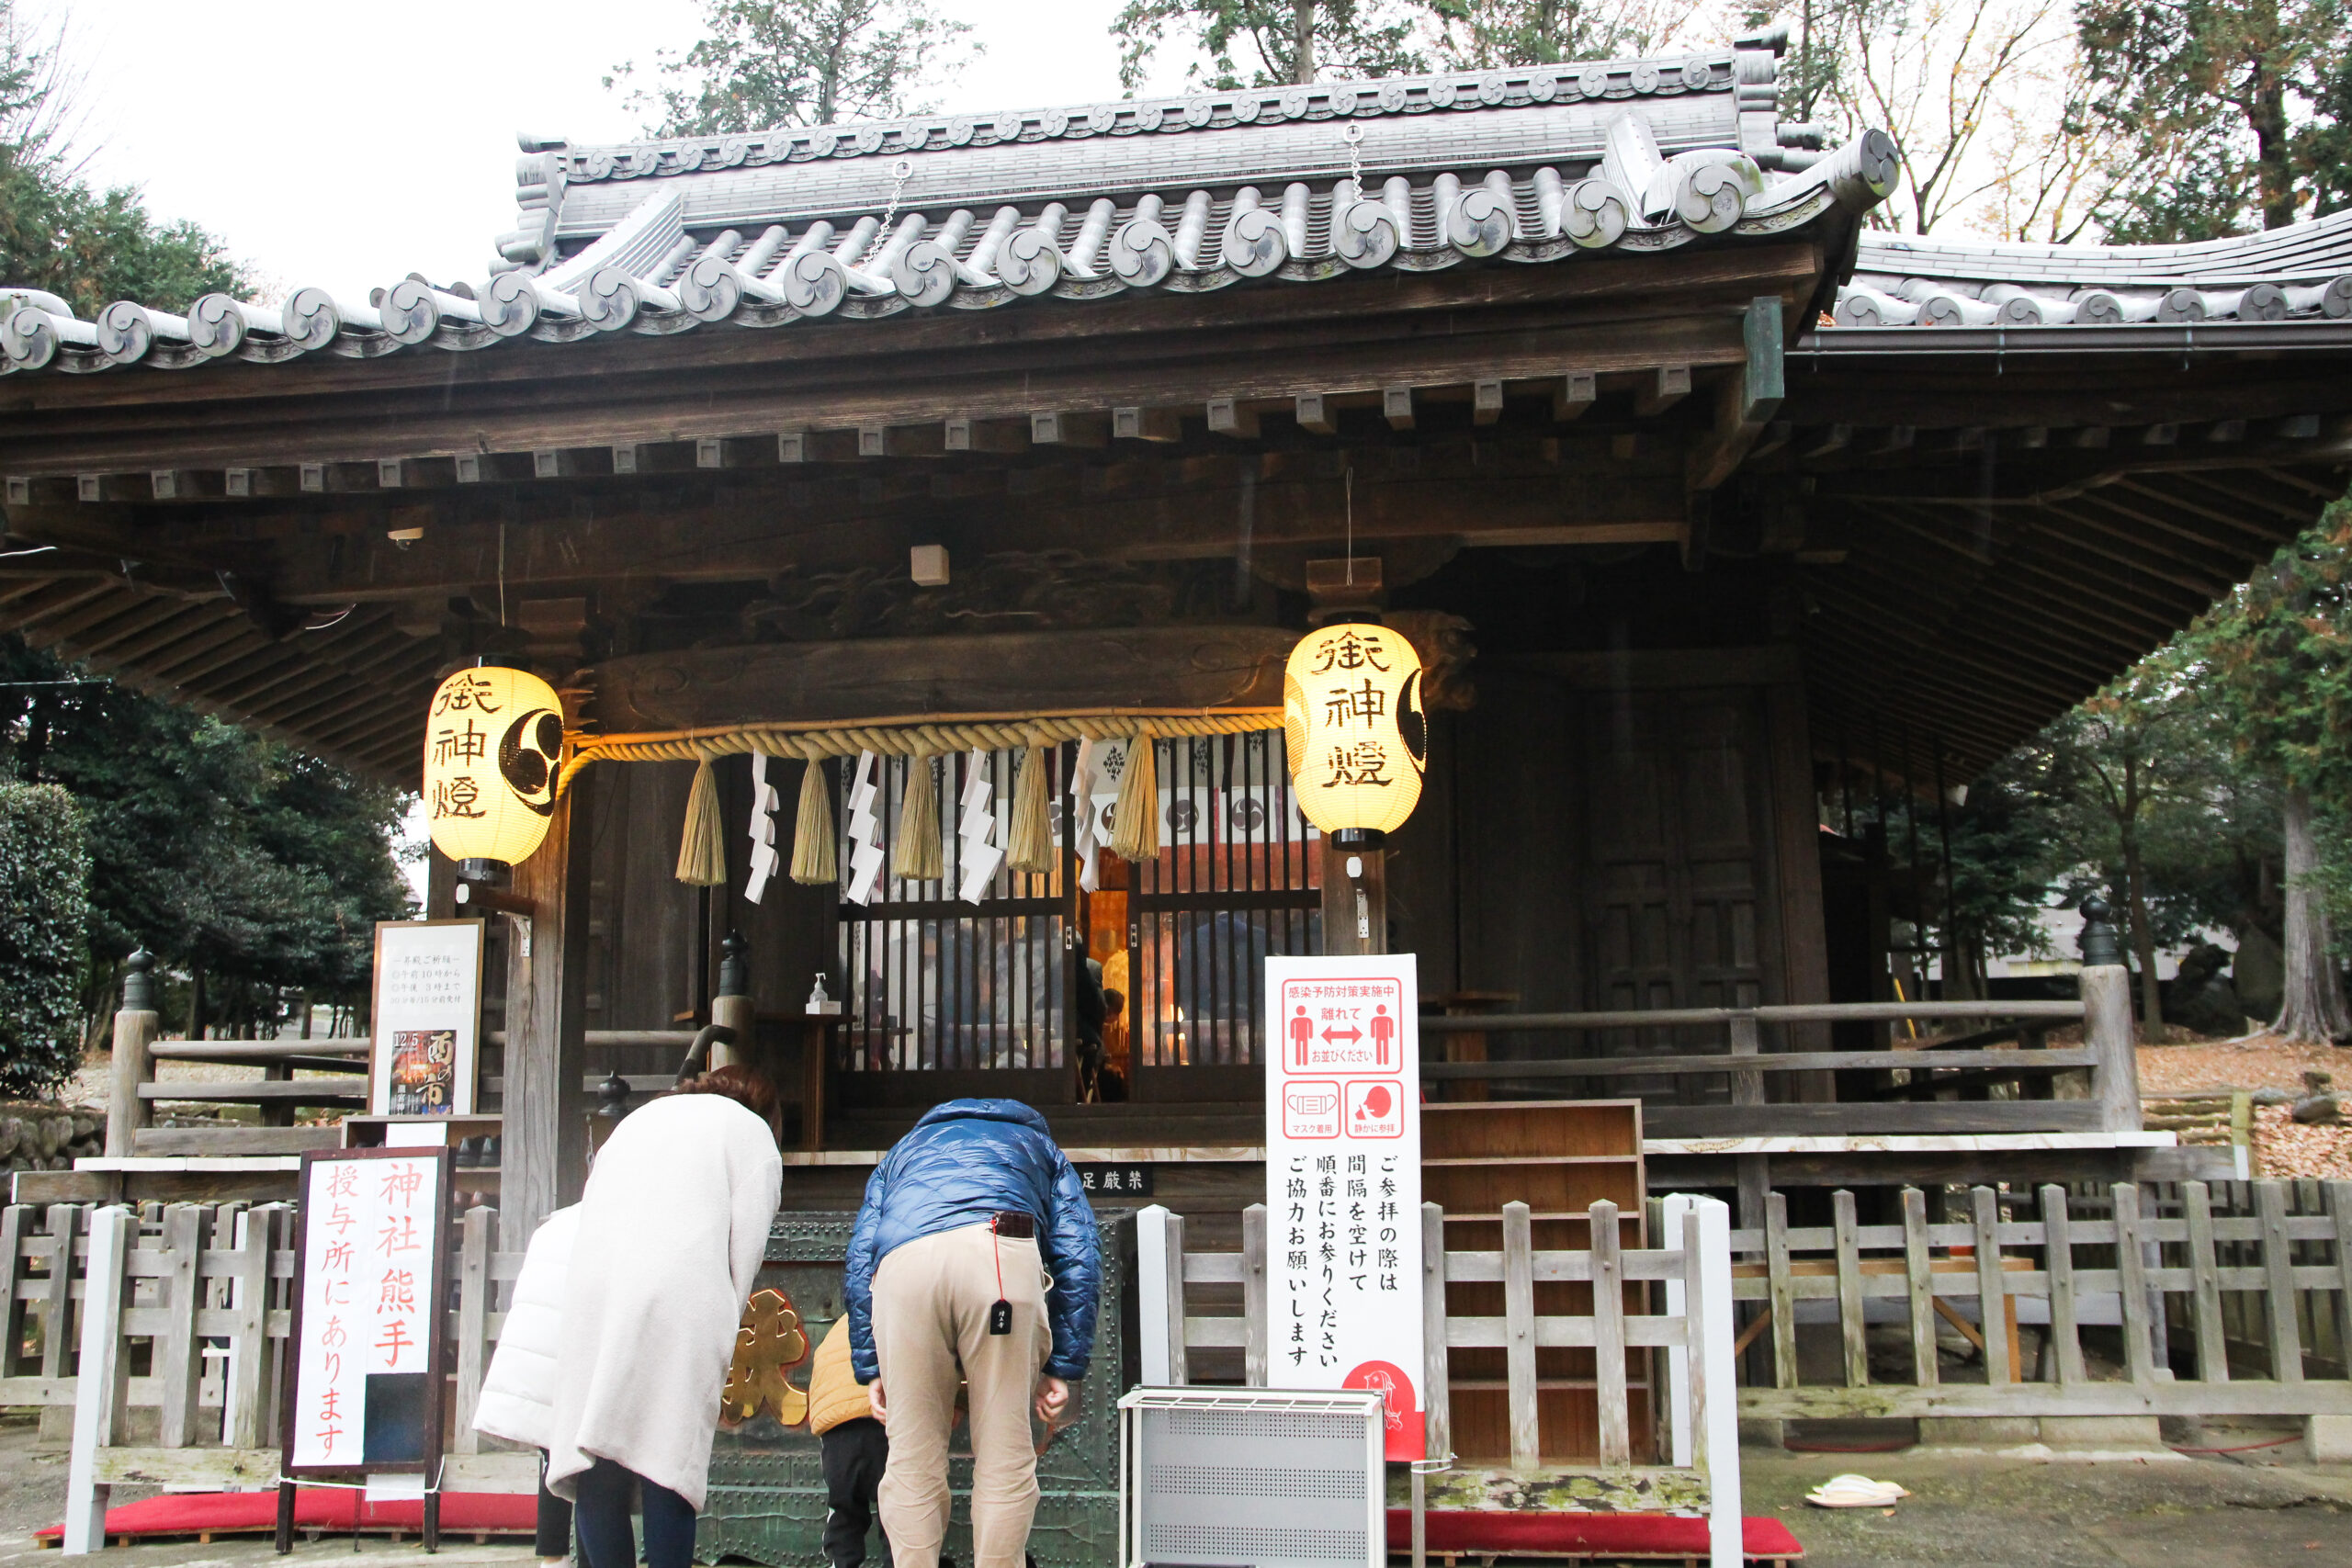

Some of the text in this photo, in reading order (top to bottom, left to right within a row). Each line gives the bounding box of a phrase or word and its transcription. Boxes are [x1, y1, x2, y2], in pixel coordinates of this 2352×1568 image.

[1288, 986, 1395, 998] 感染予防対策実施中
[1321, 1007, 1362, 1021] 離れて
[1312, 1049, 1373, 1063] お並びください
[1293, 1123, 1332, 1134] マスク着用
[1354, 1123, 1395, 1134] 静かに参拝
[1082, 1170, 1143, 1190] 足厳禁
[1286, 1156, 1308, 1367] ご協力お願いします
[1317, 1155, 1338, 1367] 順番にお参りください
[1347, 1154, 1367, 1291] 間隔を空けて
[1377, 1155, 1399, 1291] ご参拝の際は
[375, 1163, 423, 1368] 神社熊手
[316, 1165, 359, 1461] 授与所にあります
